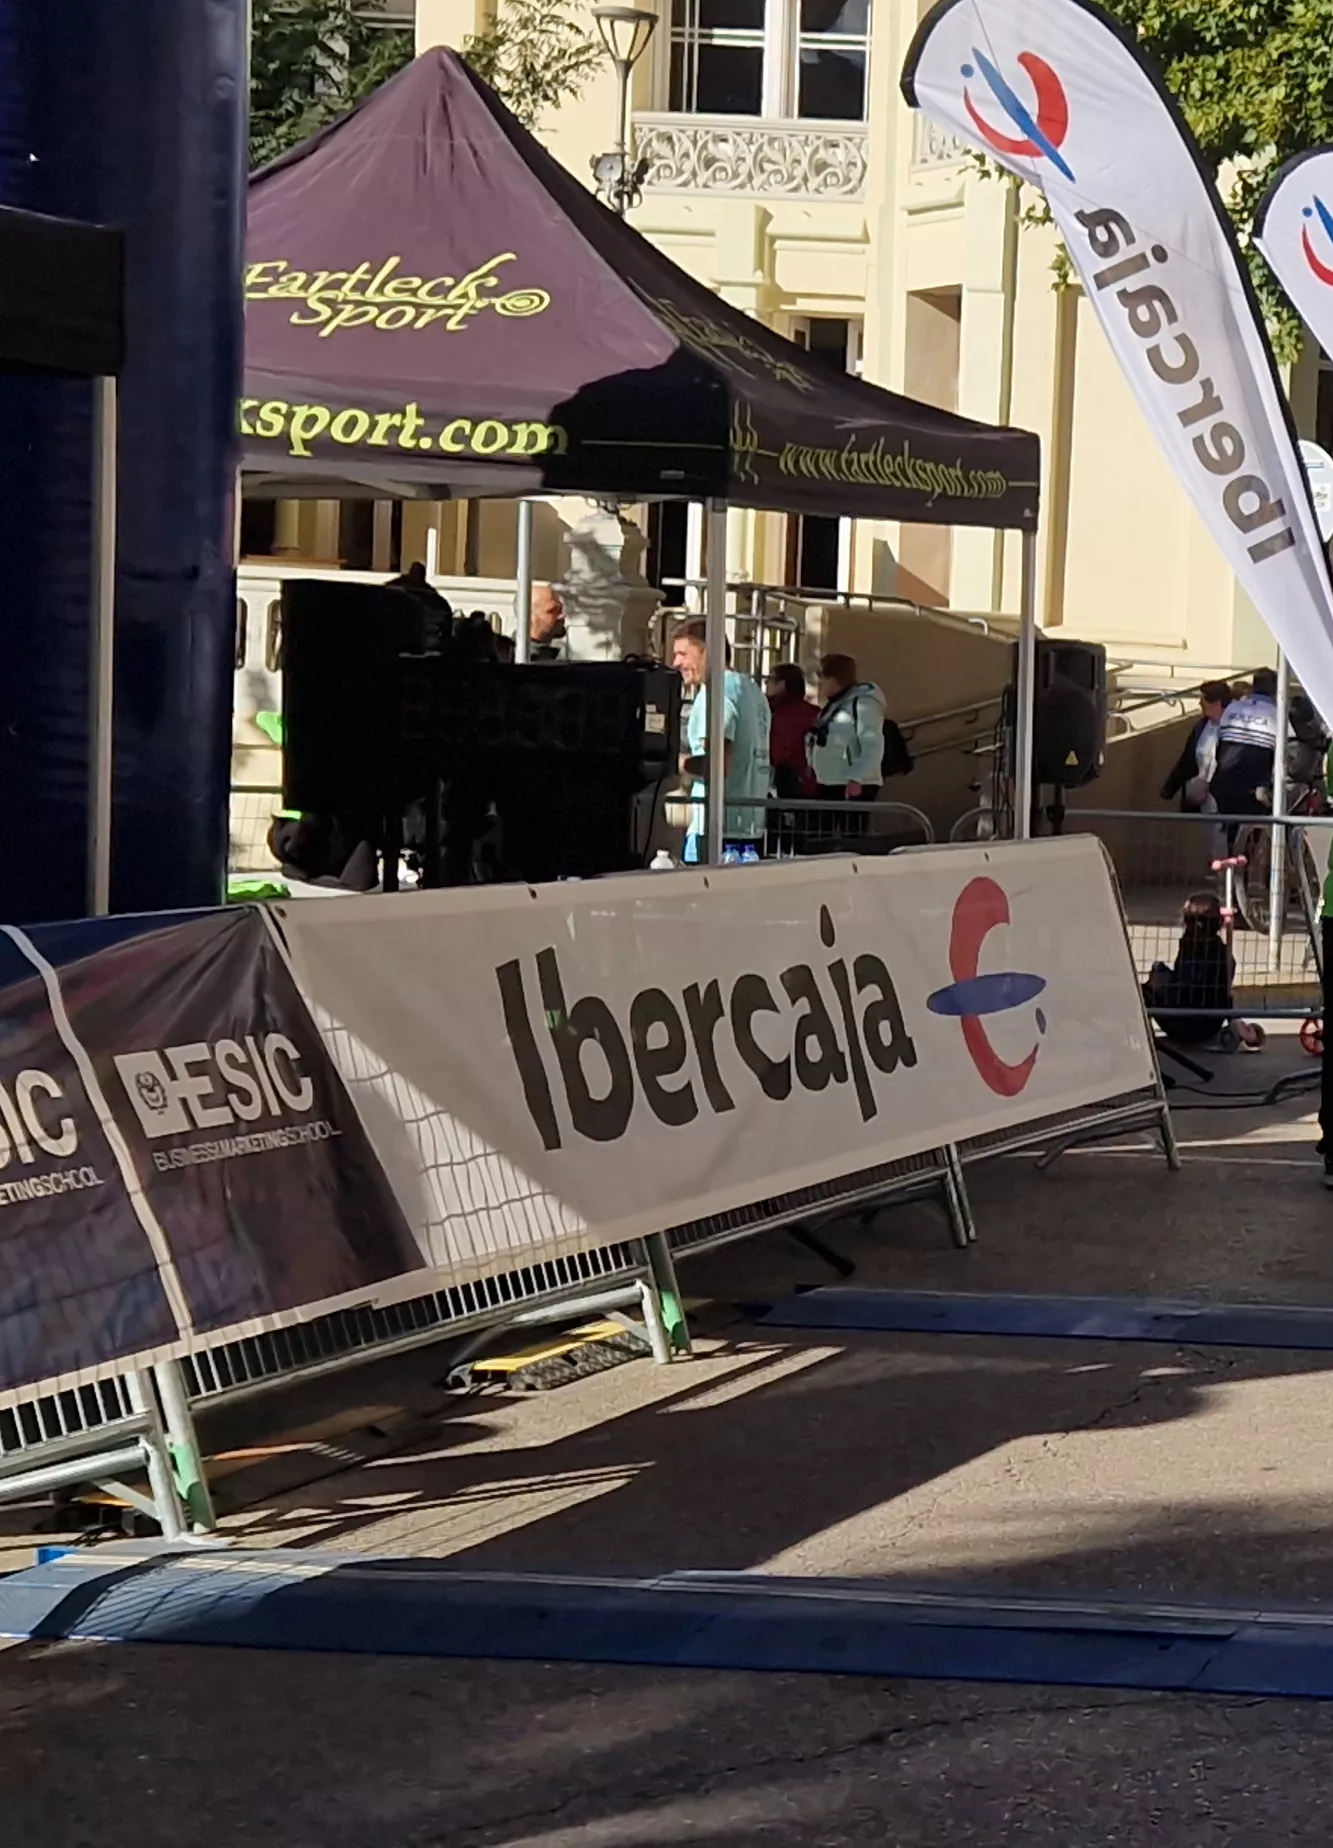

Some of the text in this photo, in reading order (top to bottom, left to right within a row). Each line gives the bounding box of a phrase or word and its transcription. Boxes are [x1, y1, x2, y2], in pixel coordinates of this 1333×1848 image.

[289, 288, 478, 338] Sport
[496, 903, 918, 1151] Ibercaja
[0, 1069, 78, 1170] IC
[165, 1032, 314, 1131] ESIC
